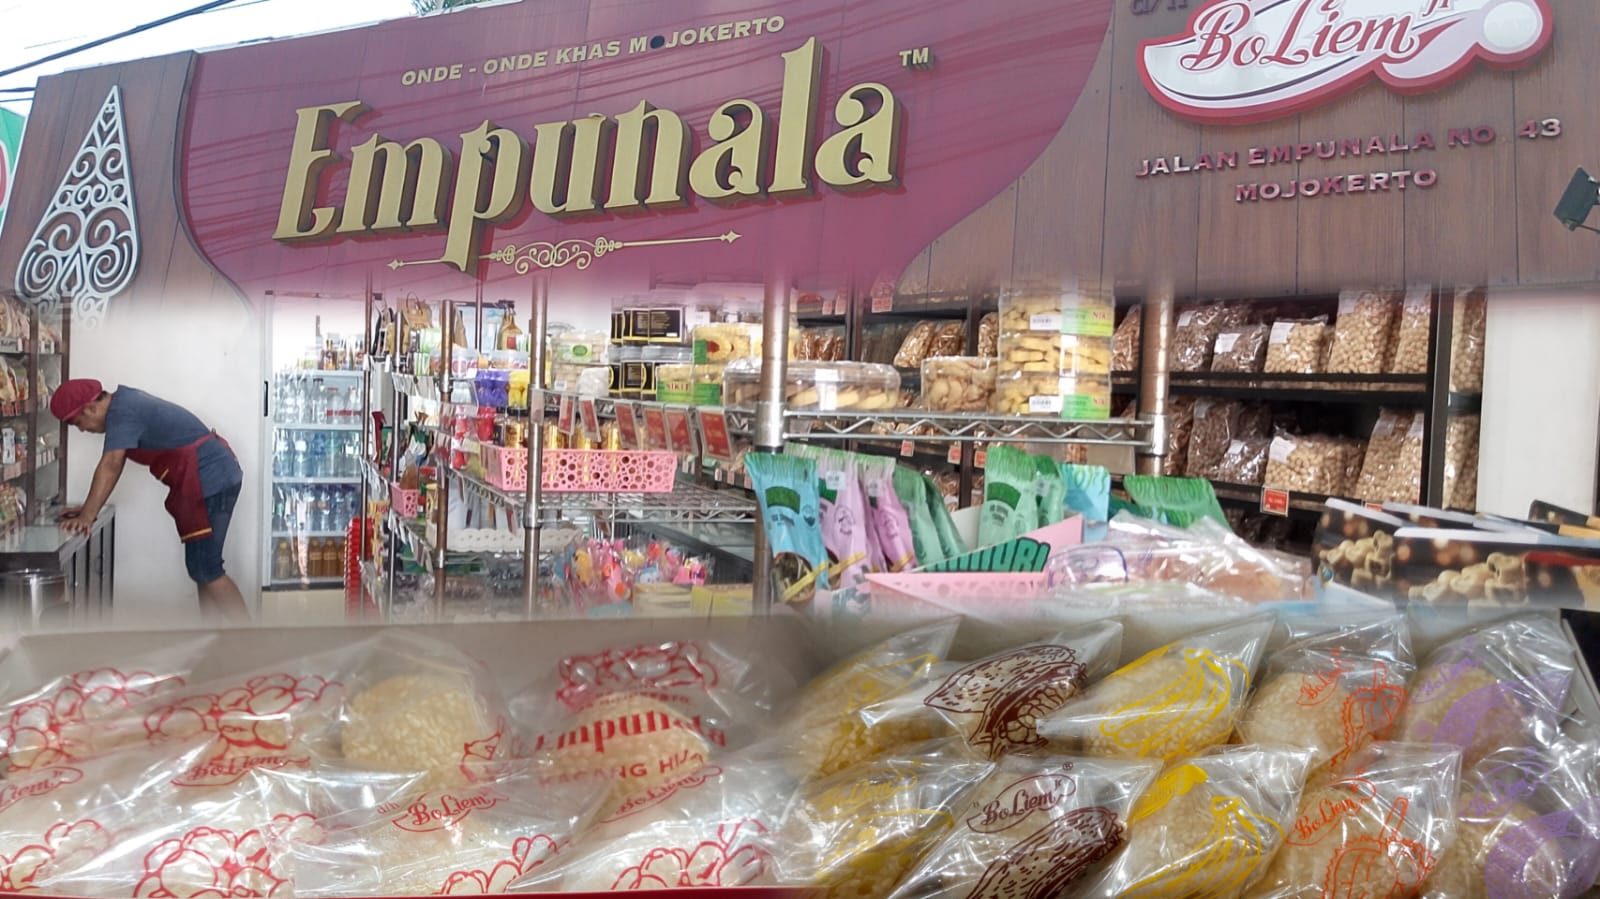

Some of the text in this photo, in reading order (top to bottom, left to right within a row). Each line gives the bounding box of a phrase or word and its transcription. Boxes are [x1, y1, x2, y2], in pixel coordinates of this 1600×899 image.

[401, 64, 463, 86] ONDE
[483, 51, 548, 74] ONDE
[555, 41, 621, 65] KHAS
[899, 47, 929, 66] TM
[272, 36, 894, 272] Empunala
[1135, 118, 1562, 178] JALAN EMPUNALA NO 43
[1234, 168, 1437, 202] MOJOKERTO
